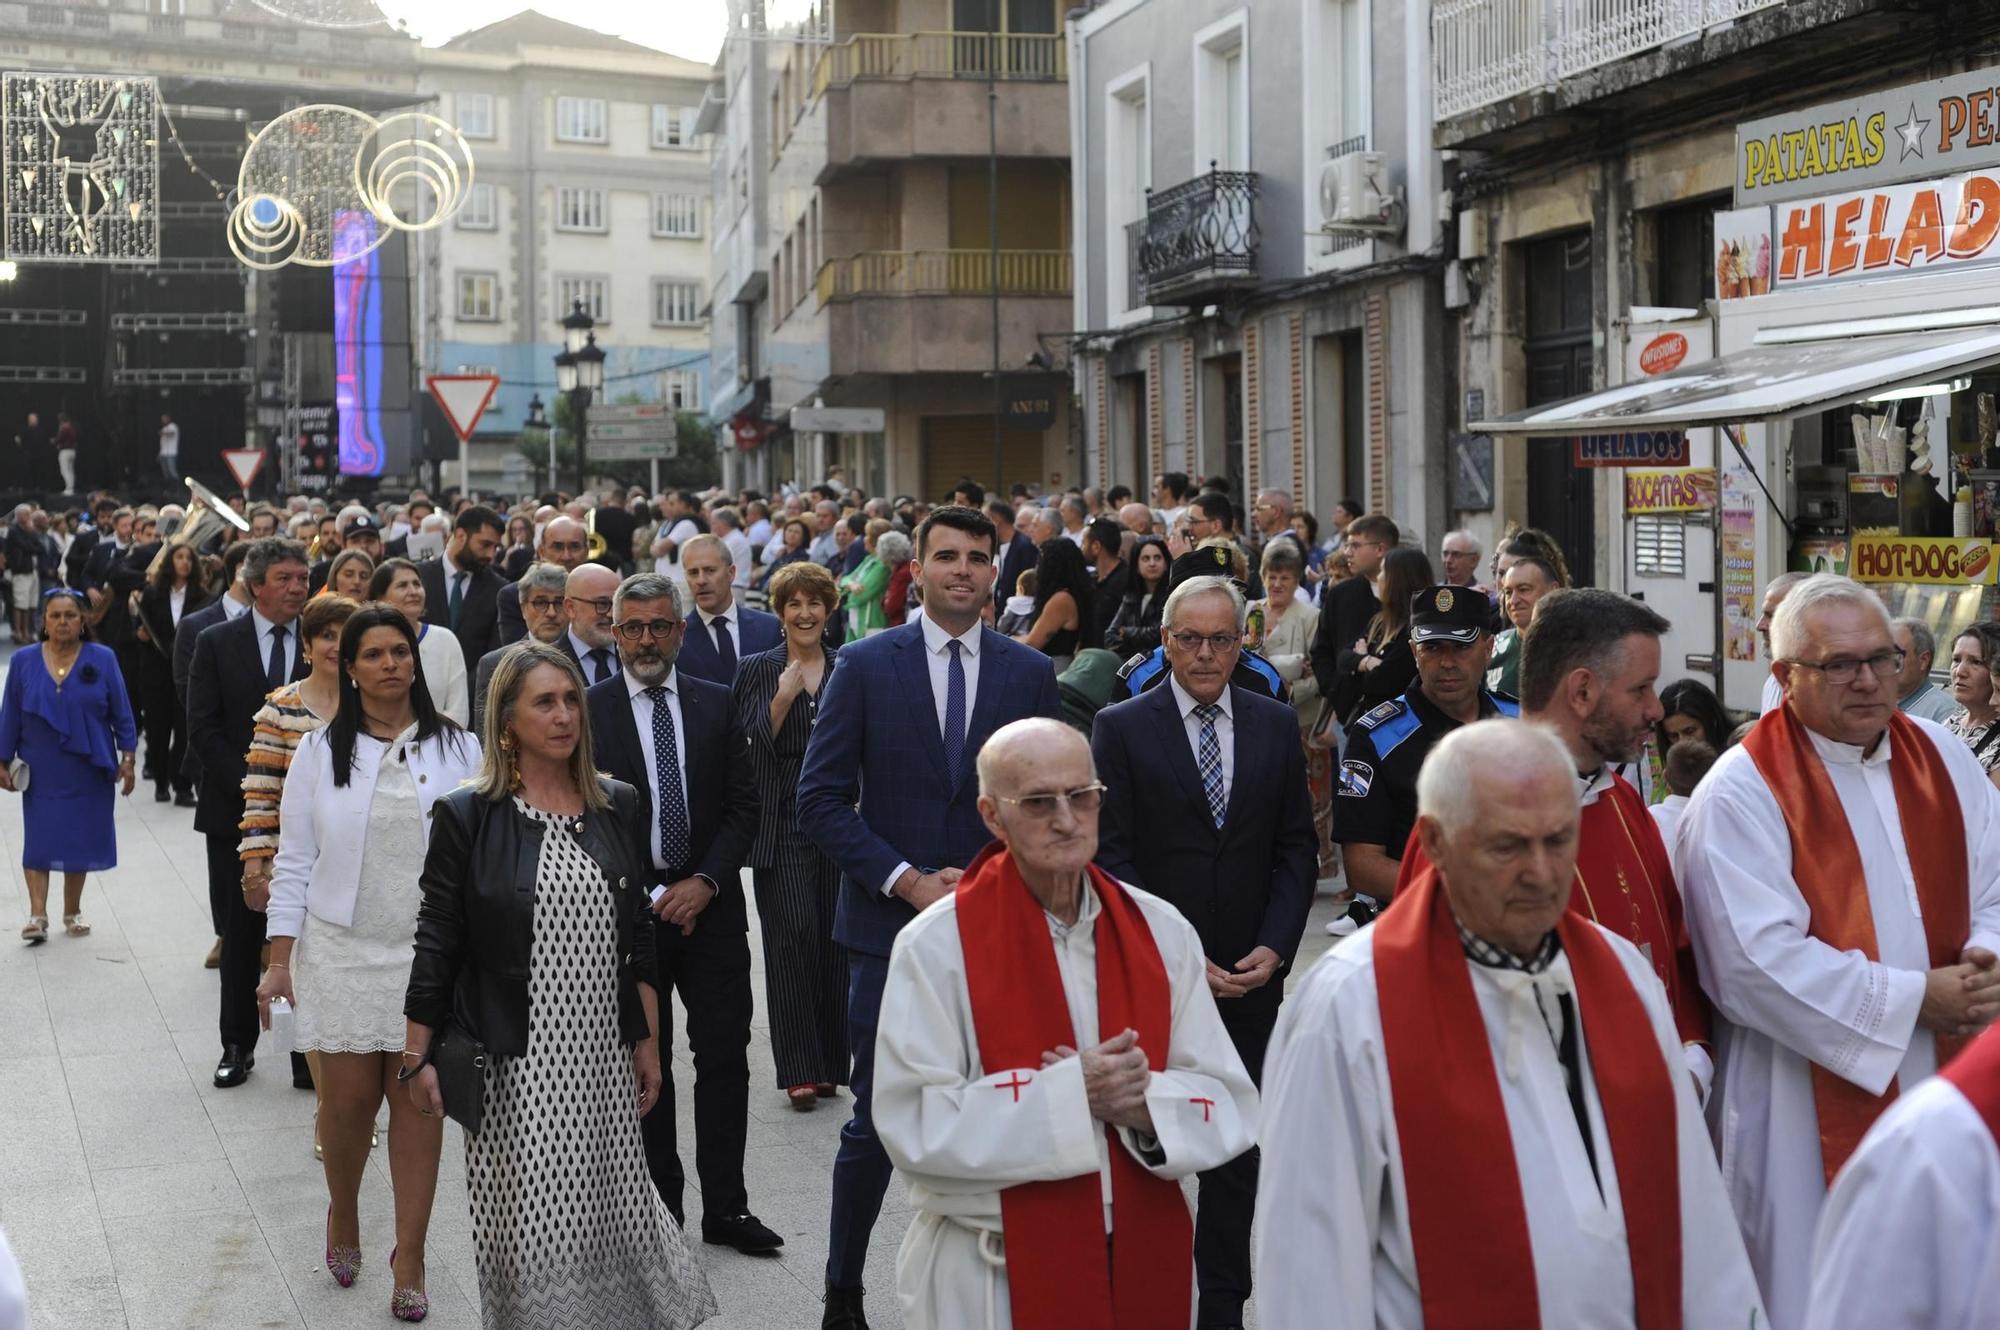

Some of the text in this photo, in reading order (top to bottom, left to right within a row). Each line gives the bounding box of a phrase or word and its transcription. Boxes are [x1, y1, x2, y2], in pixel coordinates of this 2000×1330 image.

[1744, 86, 2000, 189] PATATAS PE
[1580, 430, 1682, 460] HELADOS
[1626, 473, 1698, 508] BOCATAS
[1857, 543, 1960, 578] HOT-DOG
